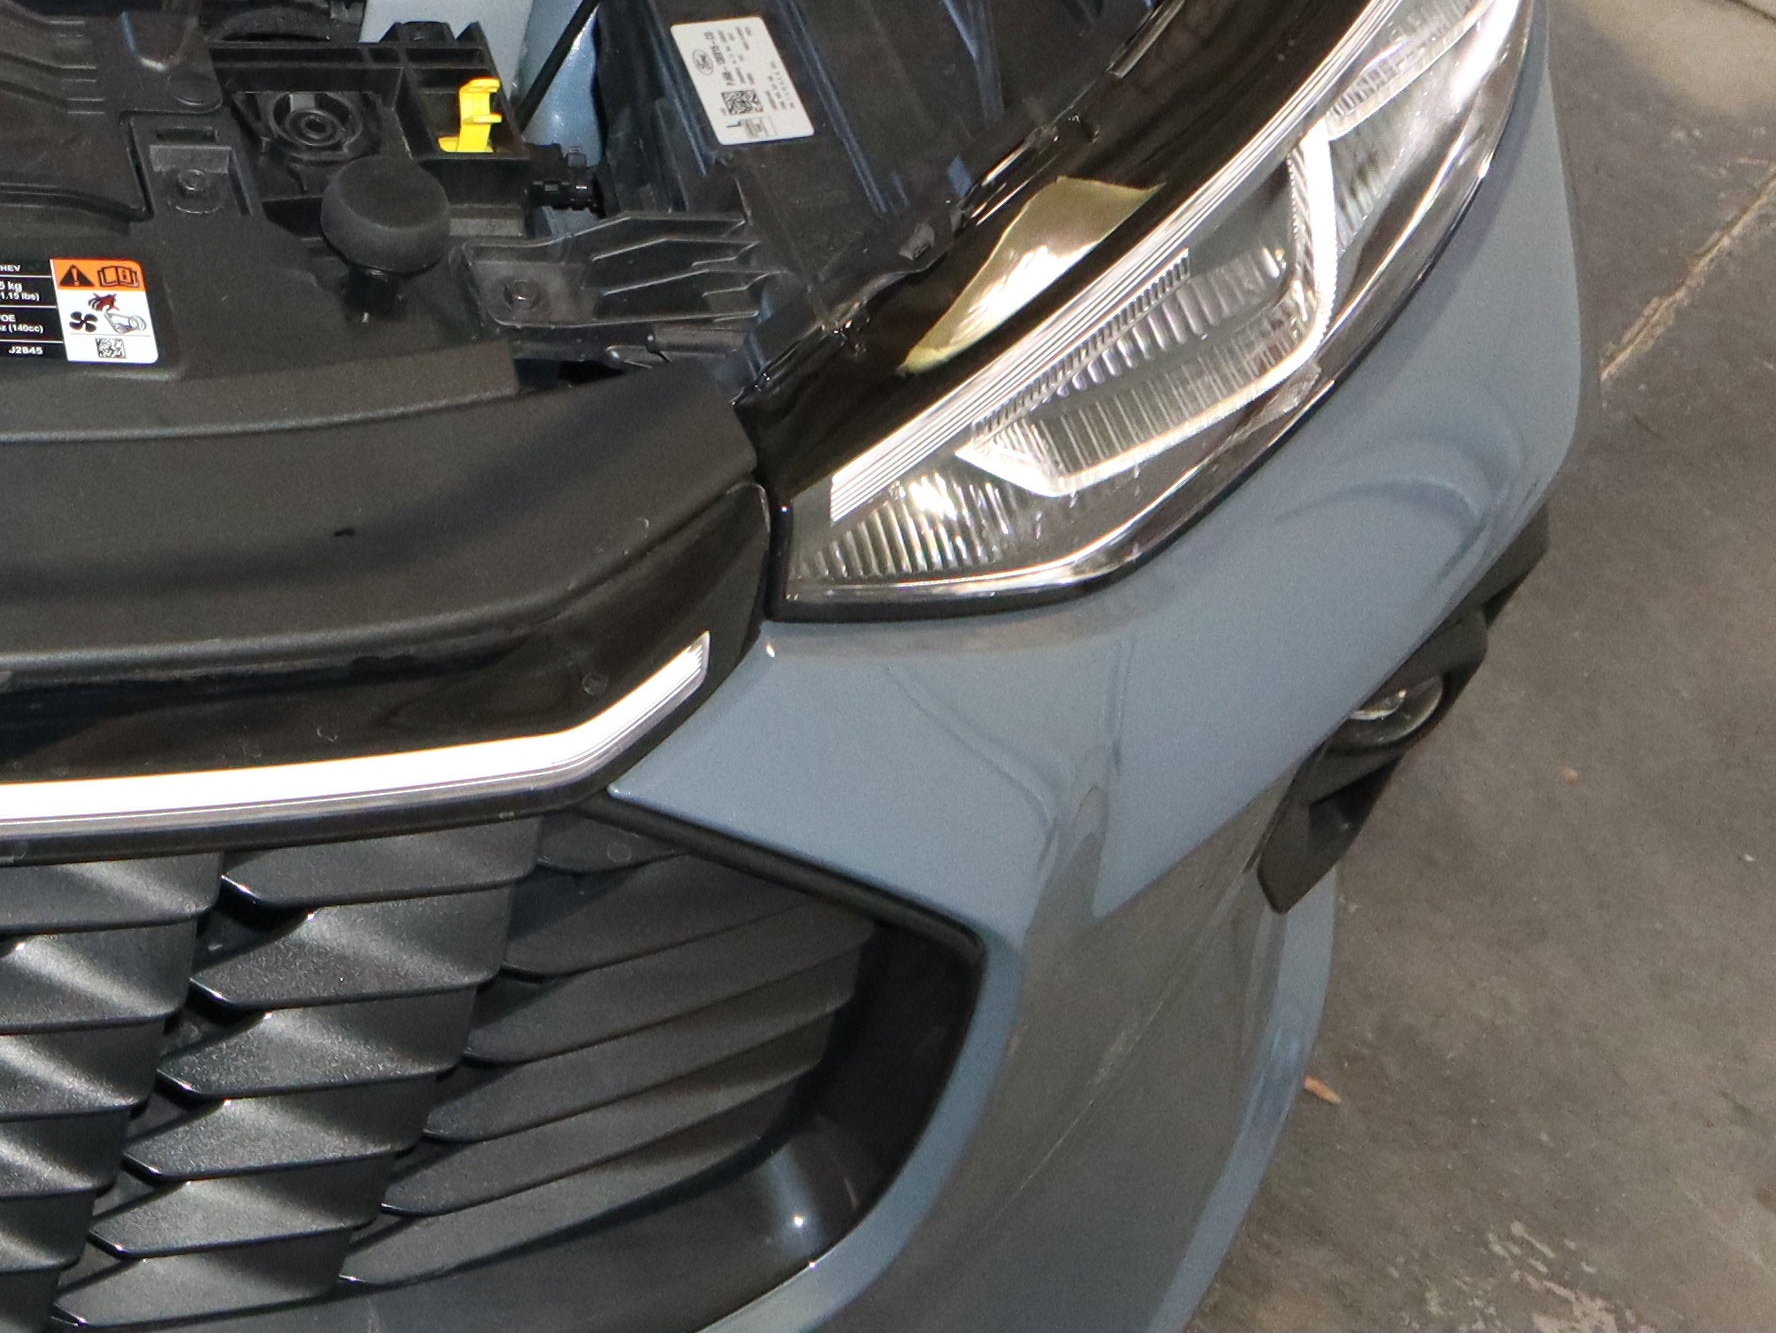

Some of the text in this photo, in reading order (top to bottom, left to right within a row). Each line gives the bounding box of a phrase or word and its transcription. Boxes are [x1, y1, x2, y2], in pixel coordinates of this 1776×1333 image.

[7, 281, 22, 293] kg
[20, 291, 40, 302] lbs)
[8, 323, 44, 334] (140cc)
